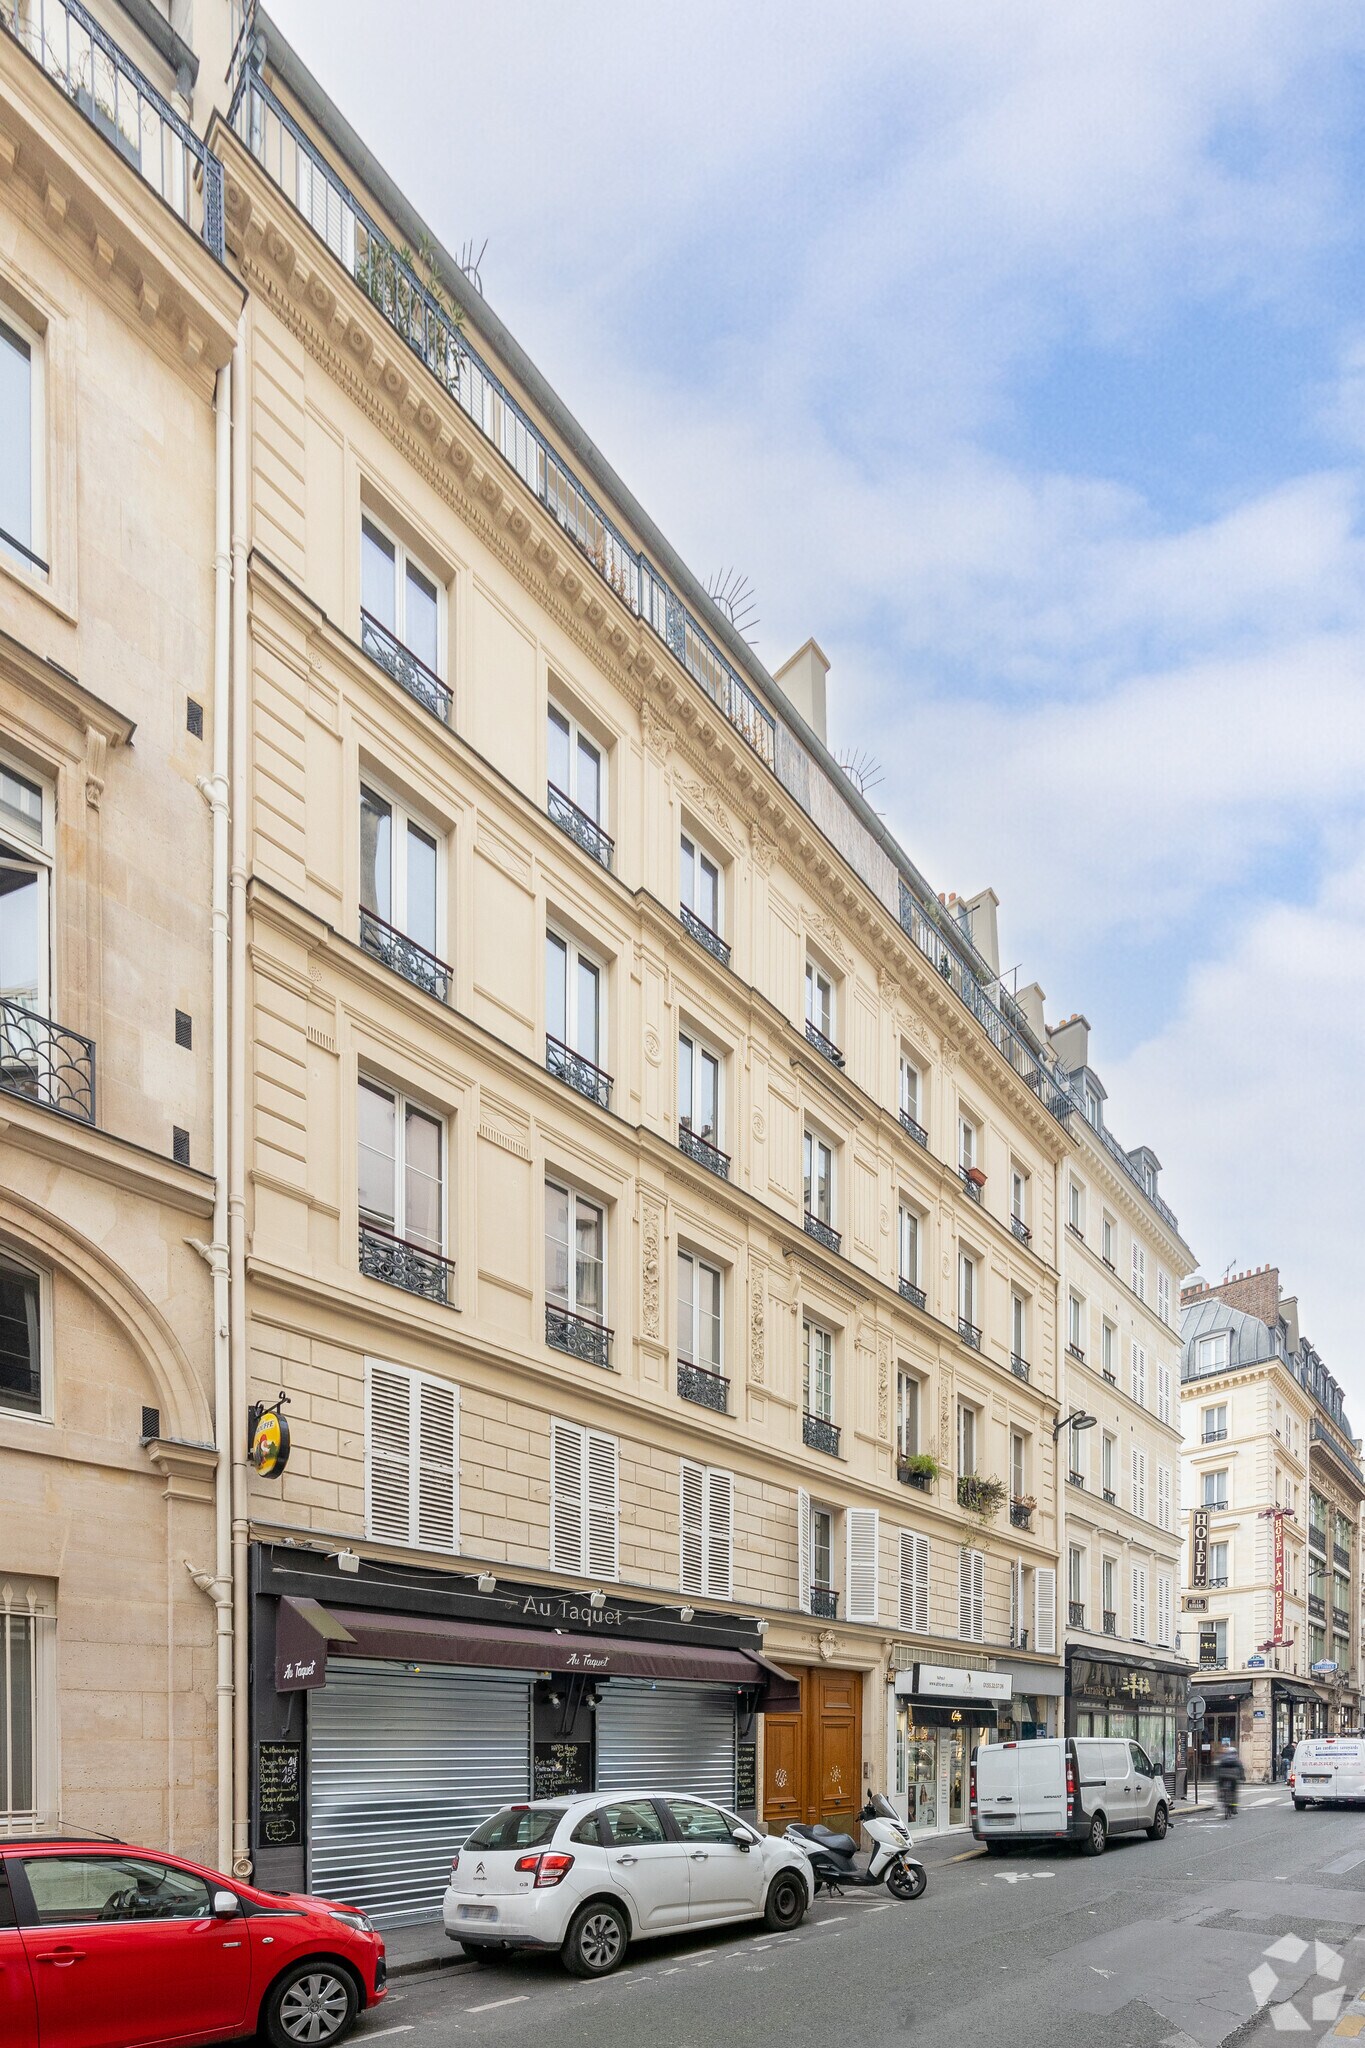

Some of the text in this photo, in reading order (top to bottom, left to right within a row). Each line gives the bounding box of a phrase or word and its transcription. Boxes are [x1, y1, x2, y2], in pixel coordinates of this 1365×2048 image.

[1195, 1513, 1207, 1577] HOTEL
[522, 1595, 622, 1627] Au Taquet
[283, 1659, 316, 1680] Au Taquet
[566, 1653, 610, 1668] Au Taquet
[1083, 1683, 1105, 1697] Karaoke
